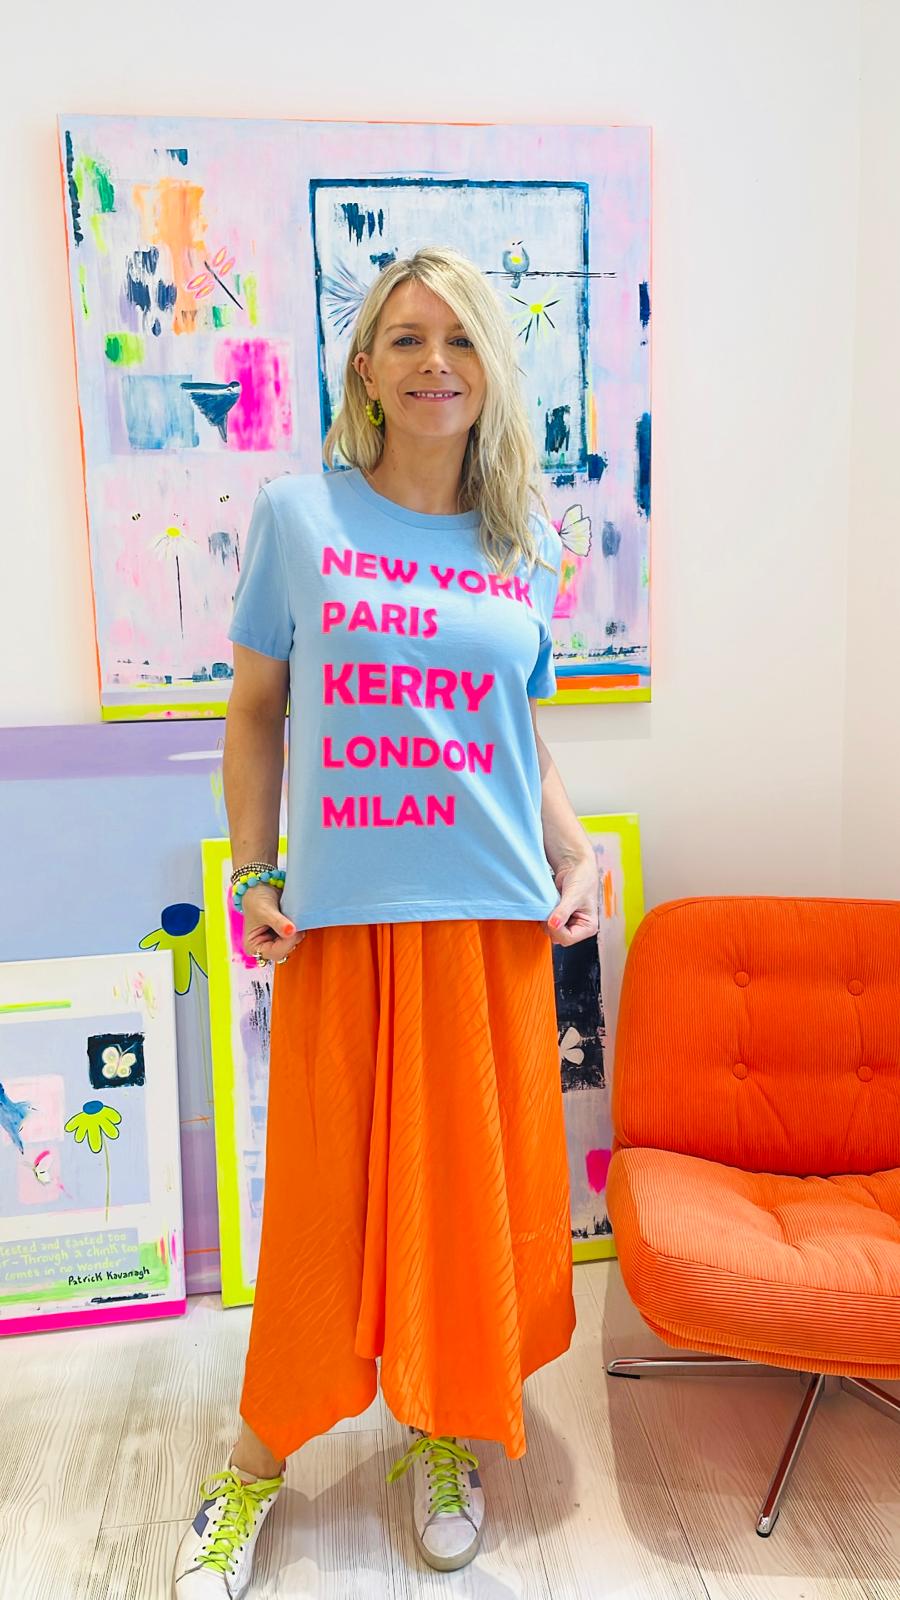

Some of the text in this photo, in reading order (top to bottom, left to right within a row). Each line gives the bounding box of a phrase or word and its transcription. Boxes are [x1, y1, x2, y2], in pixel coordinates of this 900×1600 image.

[321, 547, 533, 607] NEW YORK
[321, 601, 439, 639] PARIS
[322, 663, 495, 712] KERRY
[322, 736, 495, 774] LONDON
[321, 795, 455, 828] MILAN
[21, 1250, 69, 1266] Through
[74, 1250, 82, 1258] a
[121, 1243, 138, 1253] too
[41, 1239, 60, 1250] and
[108, 1233, 127, 1242] too
[5, 1269, 40, 1280] comes
[44, 1266, 55, 1276] in
[59, 1265, 73, 1273] no
[106, 1266, 150, 1280] Kavanagh
